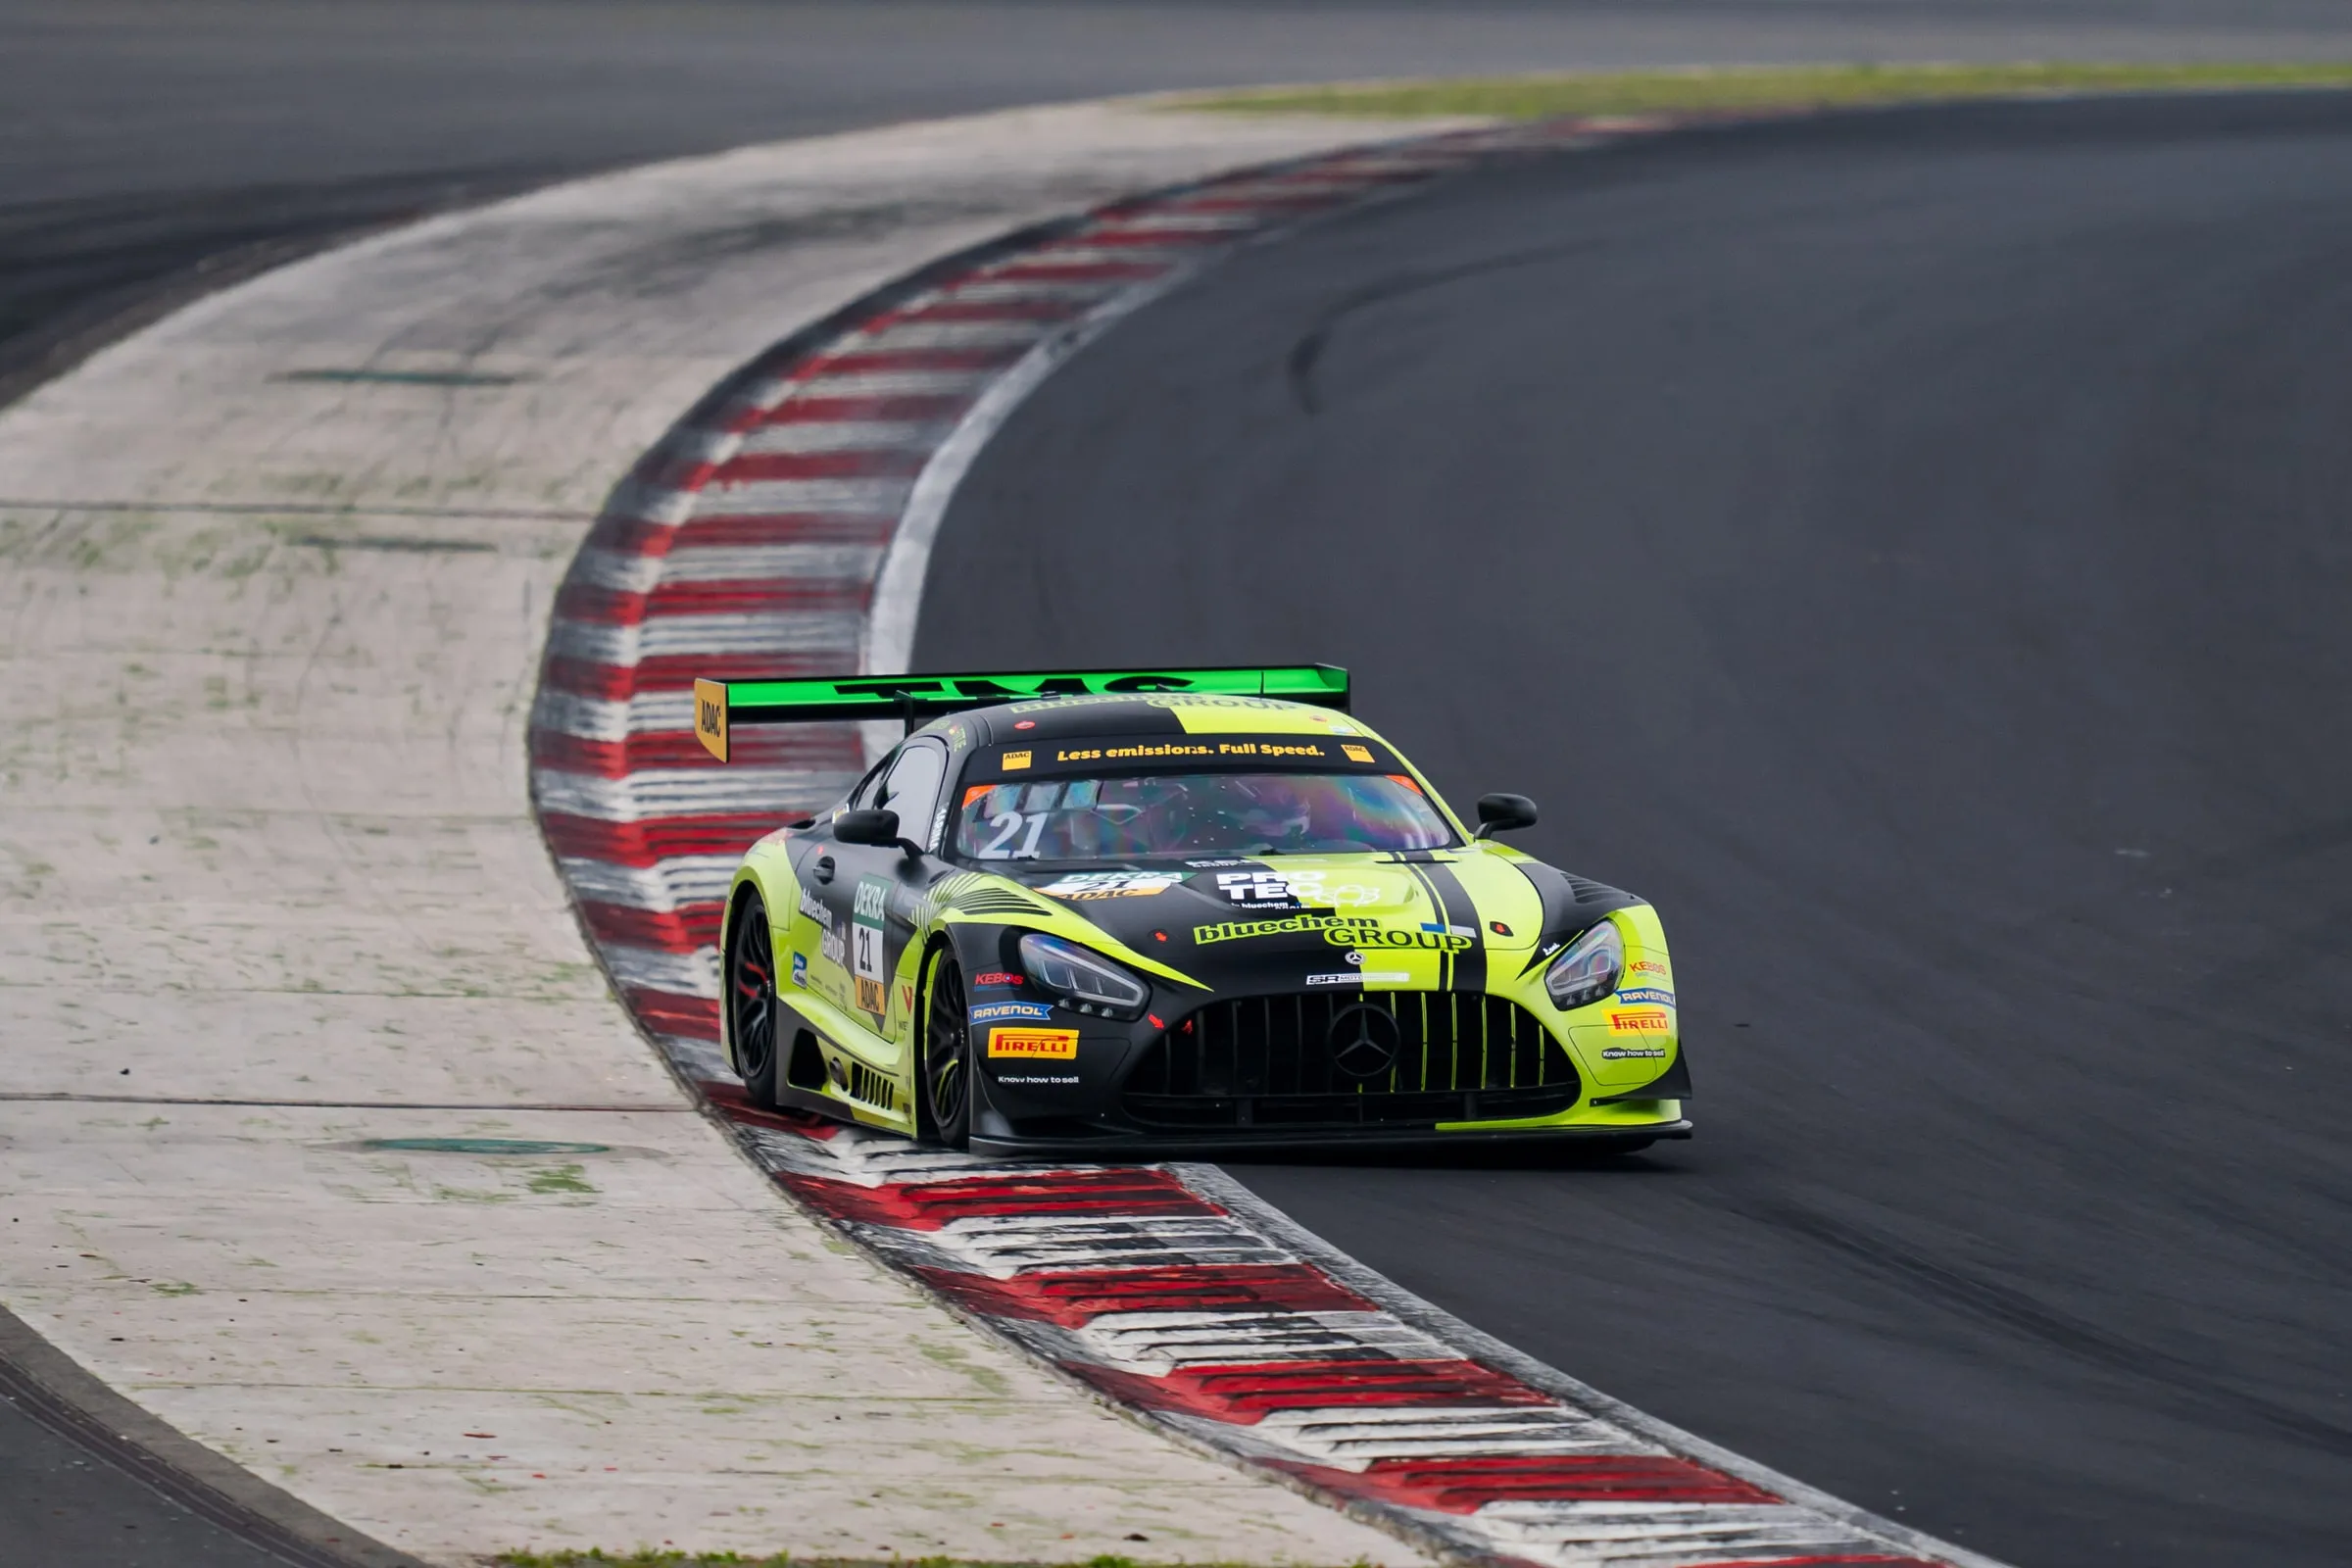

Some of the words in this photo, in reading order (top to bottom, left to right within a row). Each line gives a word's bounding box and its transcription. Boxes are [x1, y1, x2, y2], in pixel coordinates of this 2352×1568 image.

[701, 699, 721, 737] ADAC
[1004, 752, 1030, 760] ADAC
[1057, 750, 1102, 761] Less
[1105, 744, 1214, 758] emissions.
[1219, 743, 1256, 754] Full
[1260, 744, 1325, 757] Speed.
[978, 810, 1049, 858] 21
[1060, 871, 1182, 883] DEKRA
[1216, 871, 1326, 885] PRO
[1063, 889, 1140, 901] ADAC
[1074, 880, 1132, 893] 21
[855, 881, 887, 921] DEKRA
[1197, 916, 1378, 943] bluechem
[1328, 929, 1469, 951] GROUP
[858, 927, 872, 972] 21
[974, 972, 1023, 985] KEBOS
[1309, 975, 1340, 984] SR
[861, 979, 879, 1011] ADAC
[973, 1004, 1044, 1020] RAVENOL
[1610, 1011, 1669, 1030] PIRELLI
[995, 1034, 1070, 1054] PIRELLI
